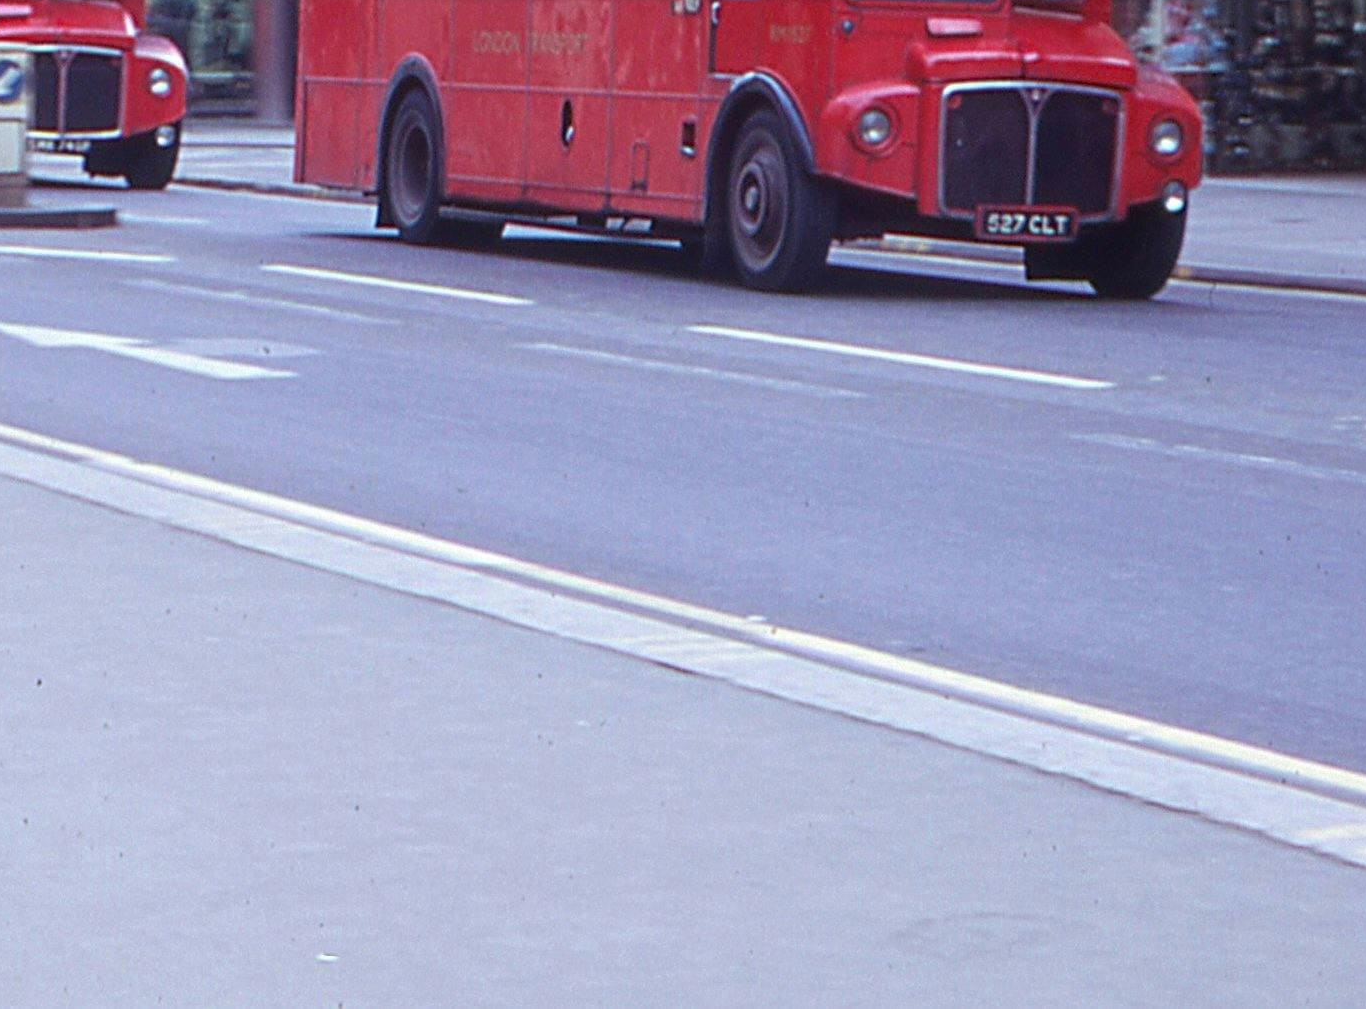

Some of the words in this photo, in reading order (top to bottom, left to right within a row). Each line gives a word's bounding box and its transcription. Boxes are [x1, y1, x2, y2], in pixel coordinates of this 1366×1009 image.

[472, 30, 520, 53] LONDON
[987, 213, 1025, 234] 527
[1028, 215, 1069, 235] CLT
